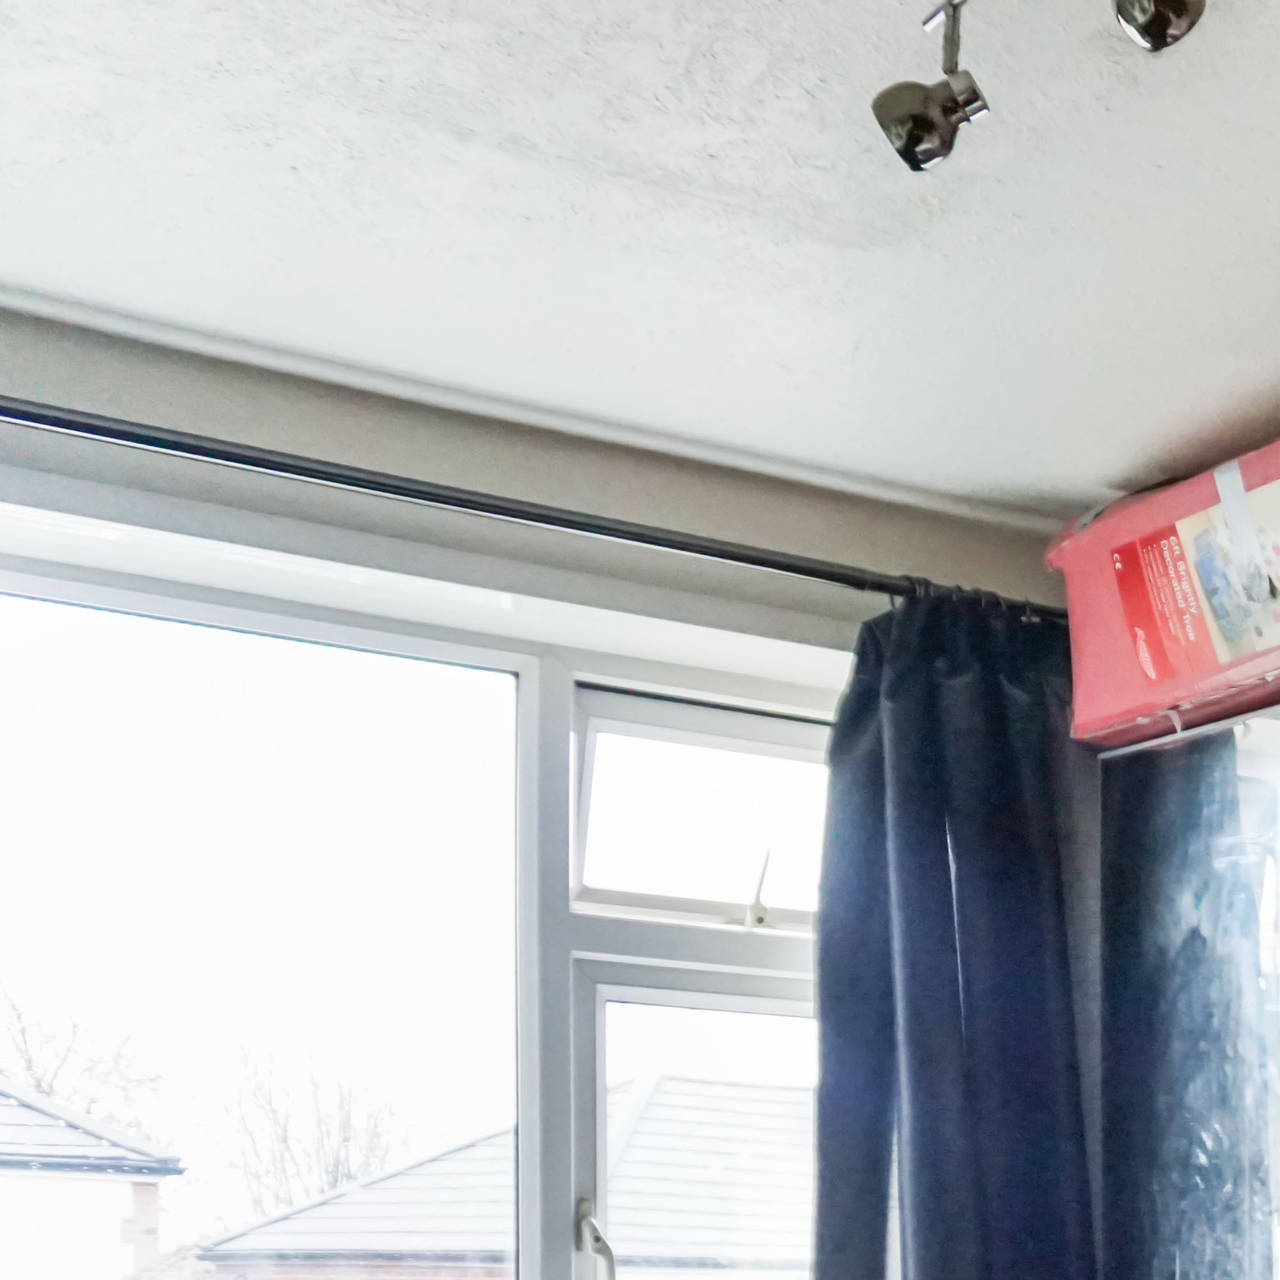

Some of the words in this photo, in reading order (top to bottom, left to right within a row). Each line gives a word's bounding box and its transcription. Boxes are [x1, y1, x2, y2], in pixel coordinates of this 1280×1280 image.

[1160, 539, 1186, 608] Decorated
[1183, 613, 1196, 641] Tree
[1177, 560, 1199, 614] Brightly
